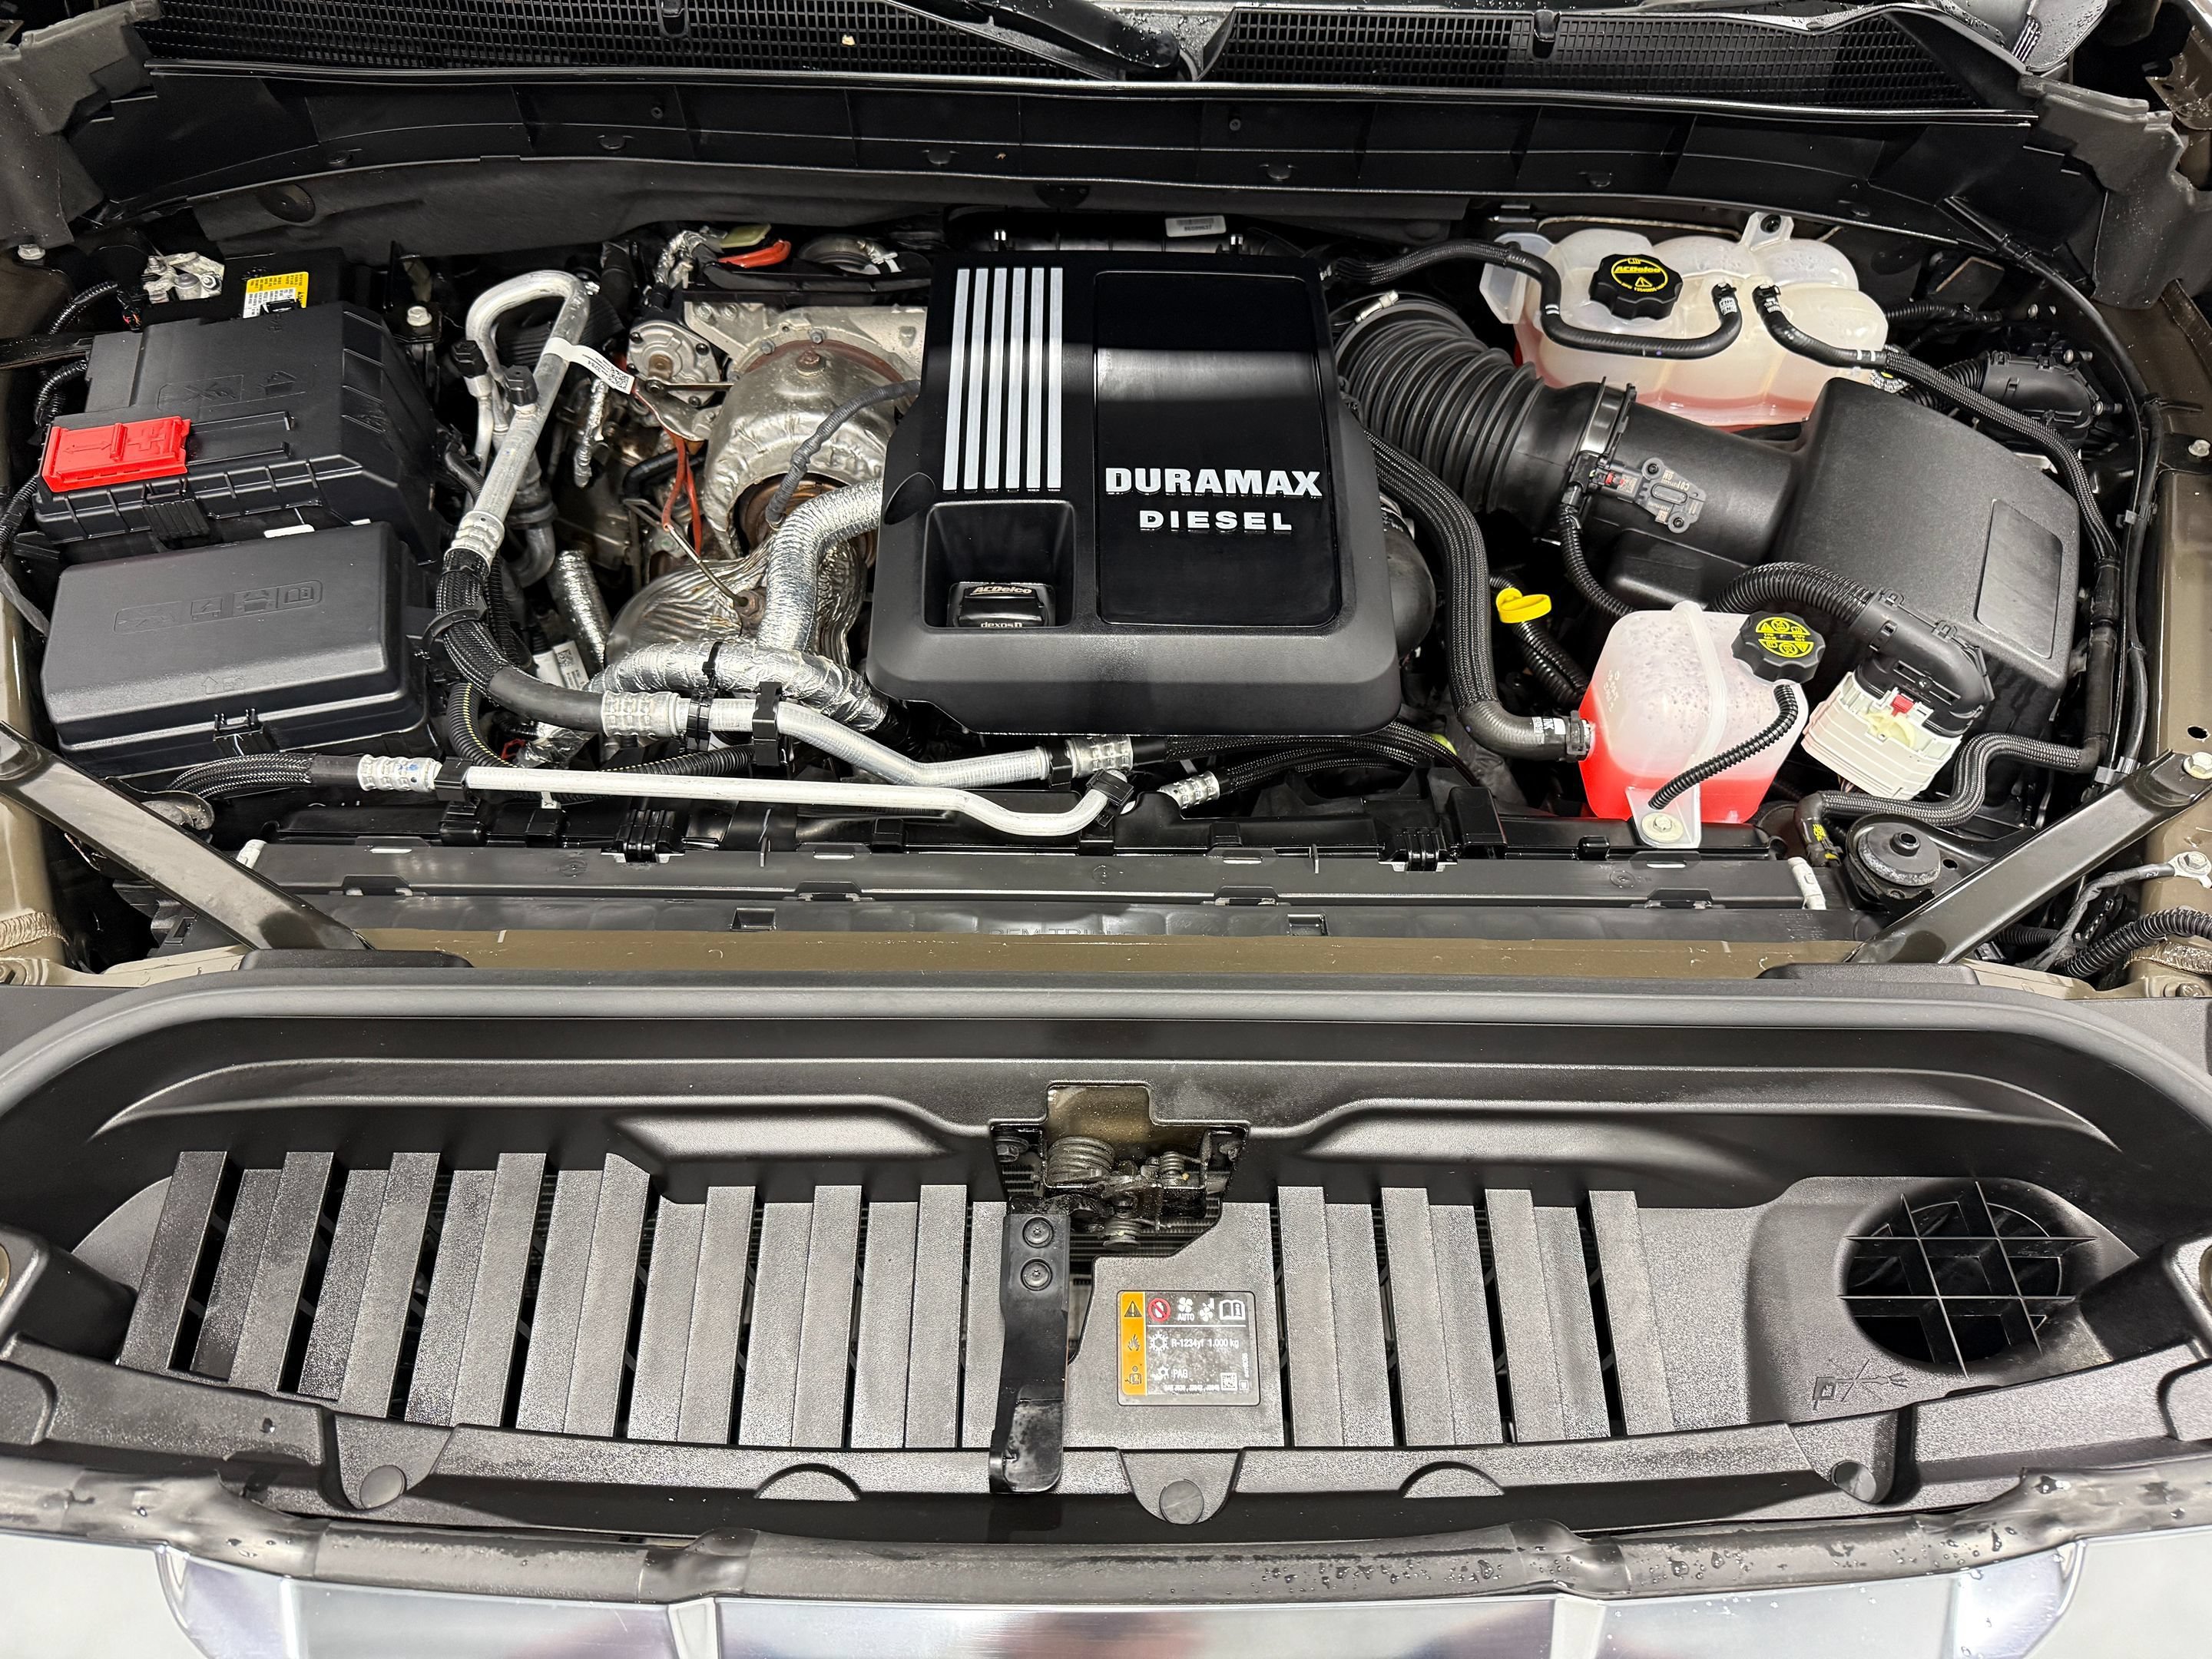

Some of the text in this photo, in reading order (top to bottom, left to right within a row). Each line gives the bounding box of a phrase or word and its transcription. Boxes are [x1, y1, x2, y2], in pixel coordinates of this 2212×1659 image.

[1614, 266, 1661, 274] ACDelco
[1105, 467, 1323, 498] DURAMAX
[1139, 510, 1292, 532] DIESEL
[971, 586, 1032, 595] ACDelco
[1171, 1338, 1240, 1349] R-1234yf 1.000 kg
[1173, 1369, 1188, 1379] PAG
